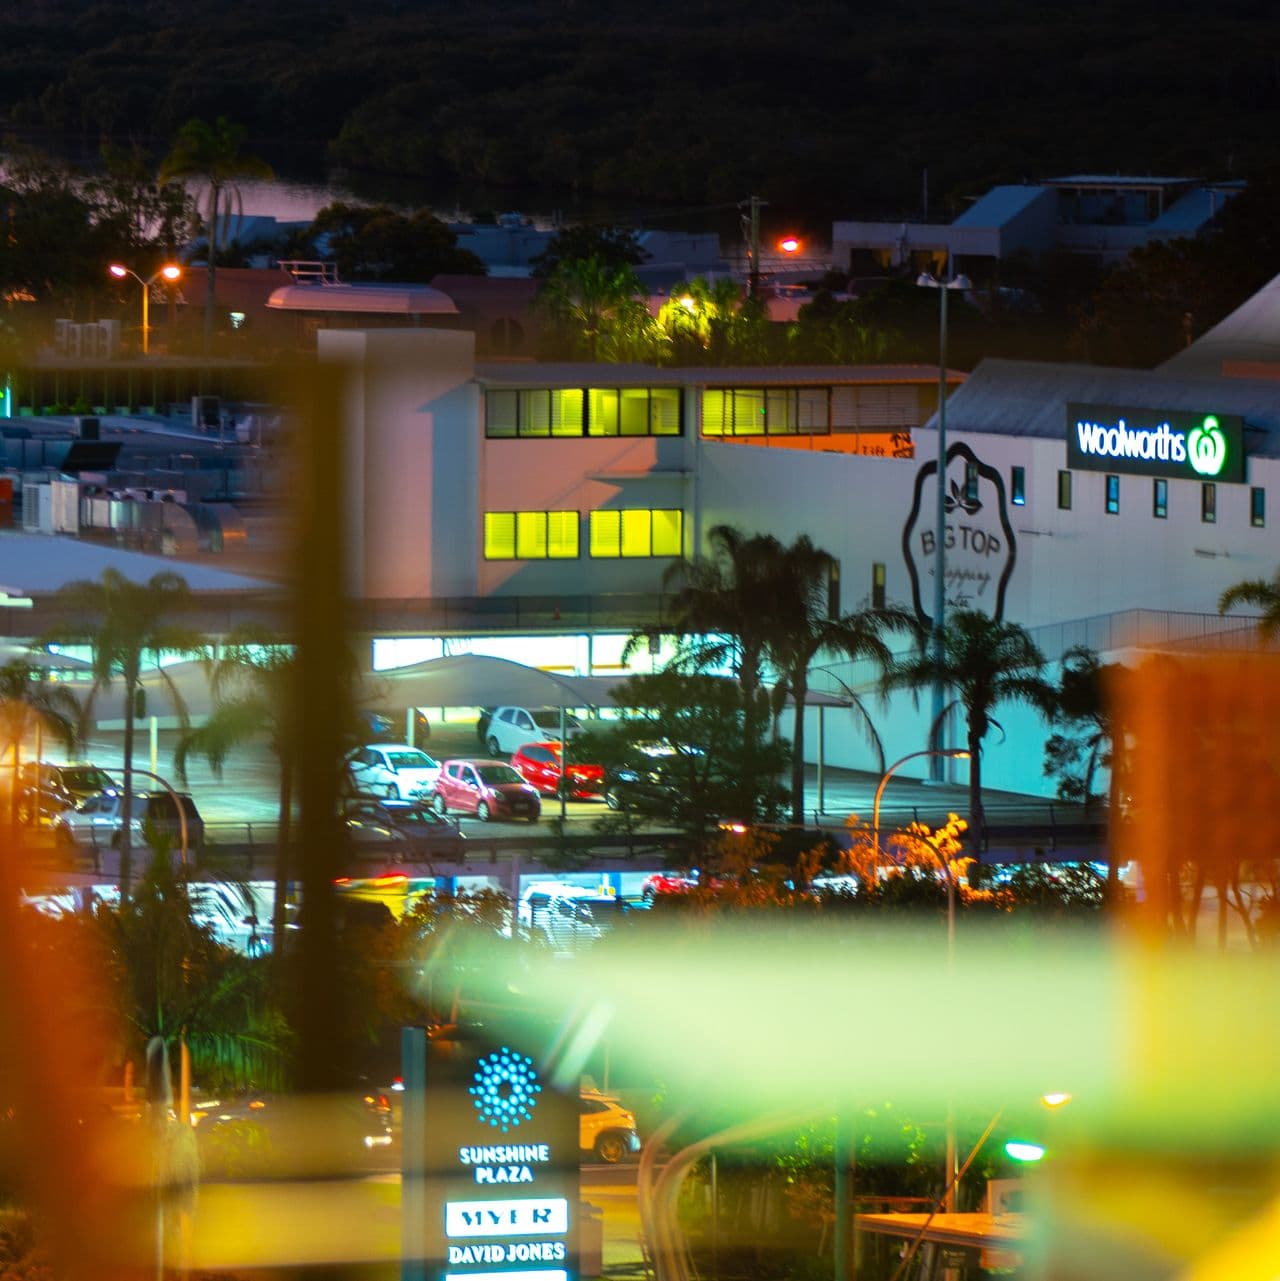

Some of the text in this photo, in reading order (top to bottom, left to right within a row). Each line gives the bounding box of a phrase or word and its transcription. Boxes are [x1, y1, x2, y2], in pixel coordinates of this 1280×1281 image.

[921, 524, 1001, 559] BG TOP
[459, 1144, 550, 1165] SUNSHINE
[475, 1165, 534, 1184] PLAZA
[461, 1208, 552, 1226] MYER
[448, 1241, 566, 1264] DAVID JONES
